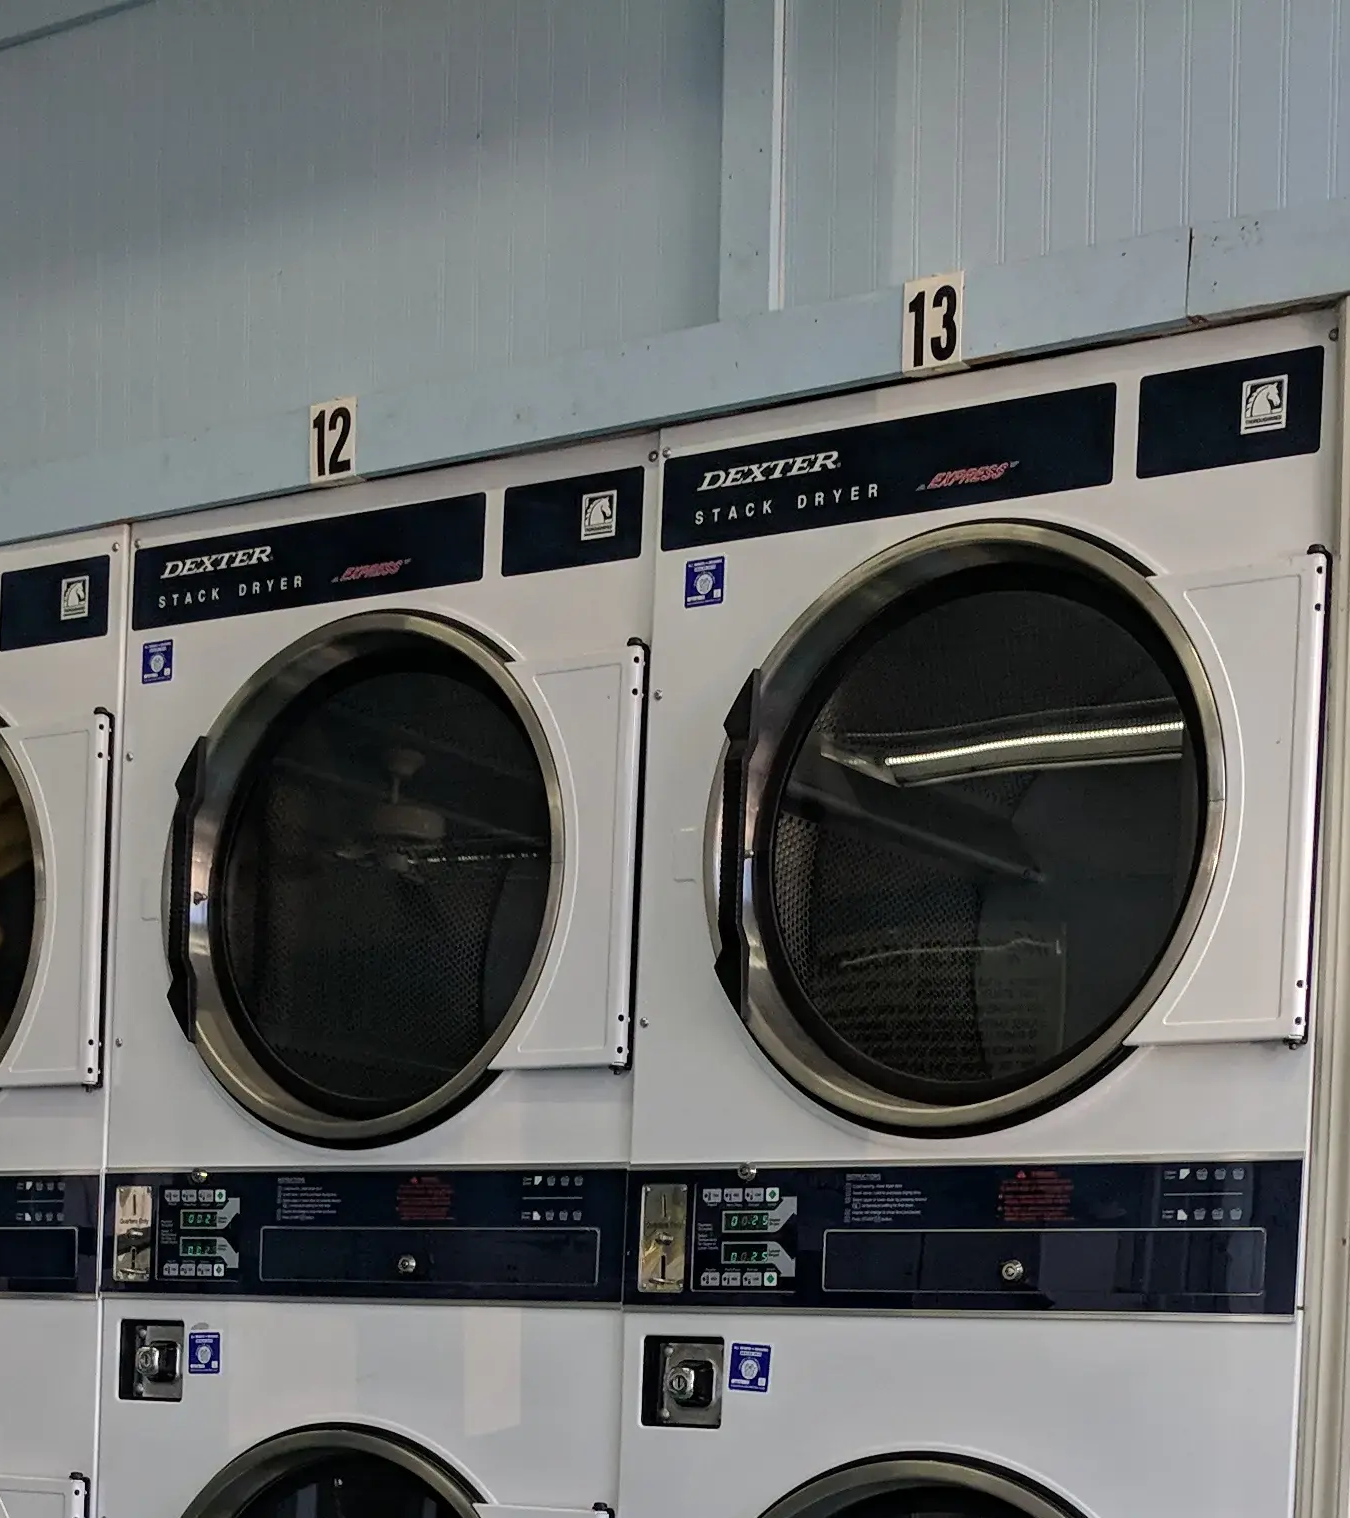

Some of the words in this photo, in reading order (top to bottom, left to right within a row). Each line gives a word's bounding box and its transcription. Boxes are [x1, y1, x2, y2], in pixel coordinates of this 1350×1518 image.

[908, 285, 957, 367] 13
[313, 406, 351, 477] 12
[697, 450, 840, 492] DEXTER
[927, 462, 1010, 491] EXPRESS
[695, 500, 773, 526] STACK
[797, 483, 879, 509] DRYER
[160, 545, 272, 579] DEXTER
[158, 588, 221, 609] STACK
[238, 575, 303, 597] DRYER
